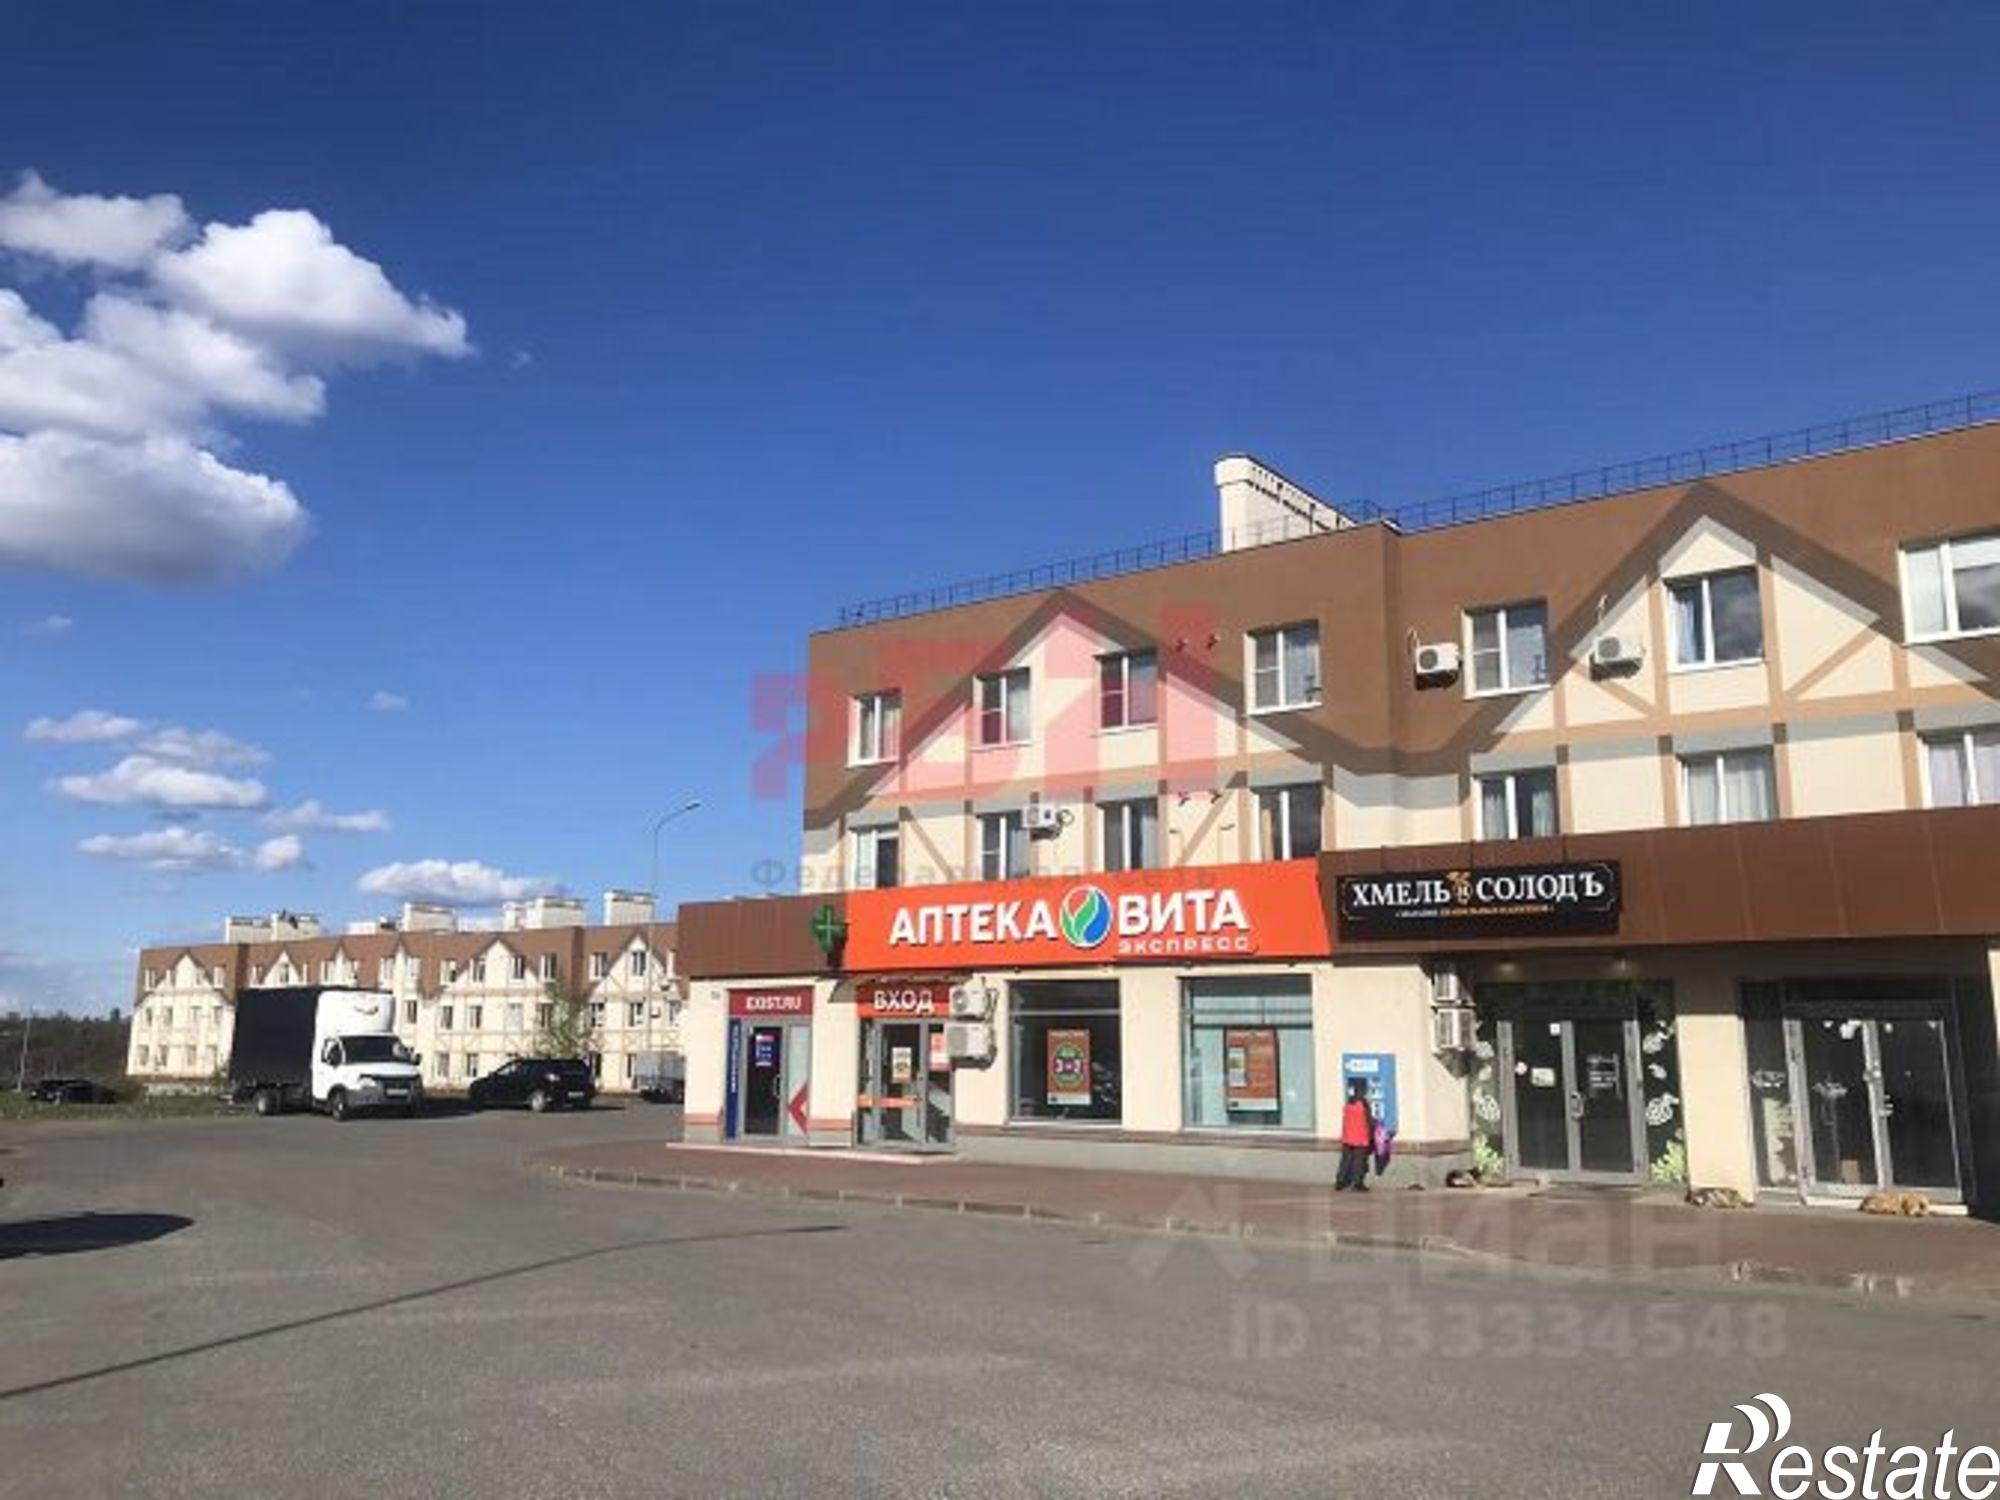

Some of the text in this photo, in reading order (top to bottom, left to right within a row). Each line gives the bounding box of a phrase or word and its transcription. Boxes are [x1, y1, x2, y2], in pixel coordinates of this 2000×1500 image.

[1352, 880, 1450, 906] ХМЕЛЬ
[1475, 872, 1605, 901] СОЛОДЪ
[889, 889, 1249, 945] АПТЕКА ВИТА
[1119, 937, 1251, 954] ЭКСПРЕСС
[874, 990, 935, 1015] ВХОД
